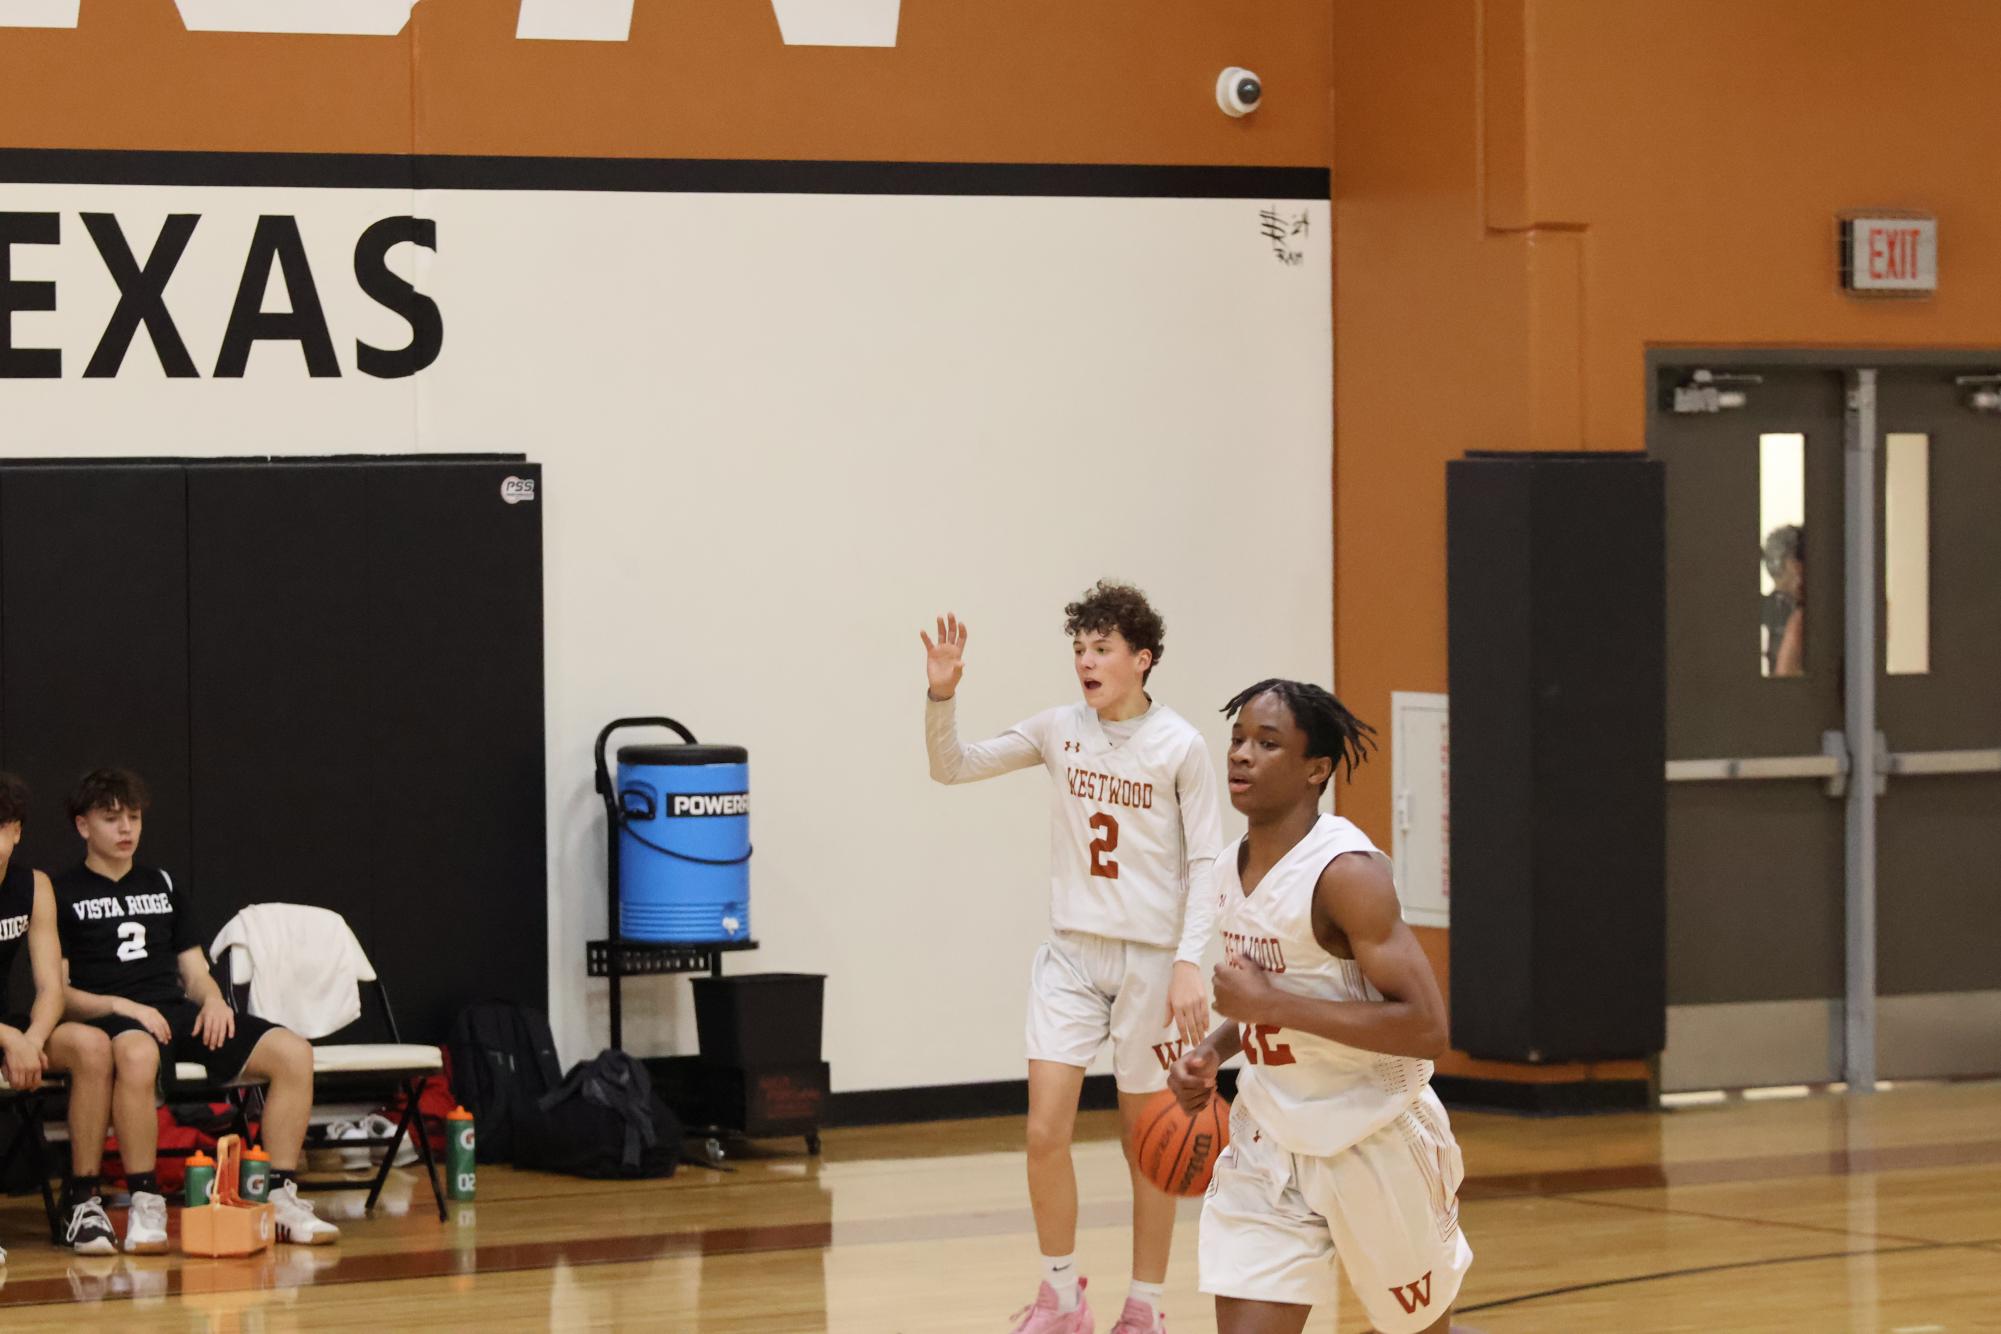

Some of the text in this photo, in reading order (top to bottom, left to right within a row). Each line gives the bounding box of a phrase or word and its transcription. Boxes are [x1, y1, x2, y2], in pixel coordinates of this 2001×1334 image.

[1869, 228, 1920, 281] EXIT
[506, 480, 533, 492] PSS
[1067, 767, 1153, 809] WESTWOOD
[1089, 811, 1119, 880] 2
[72, 892, 173, 921] VISTA RIDGE
[116, 921, 148, 962] 2
[1151, 1038, 1183, 1071] W
[246, 1174, 265, 1195] G
[1388, 1270, 1432, 1315] W
